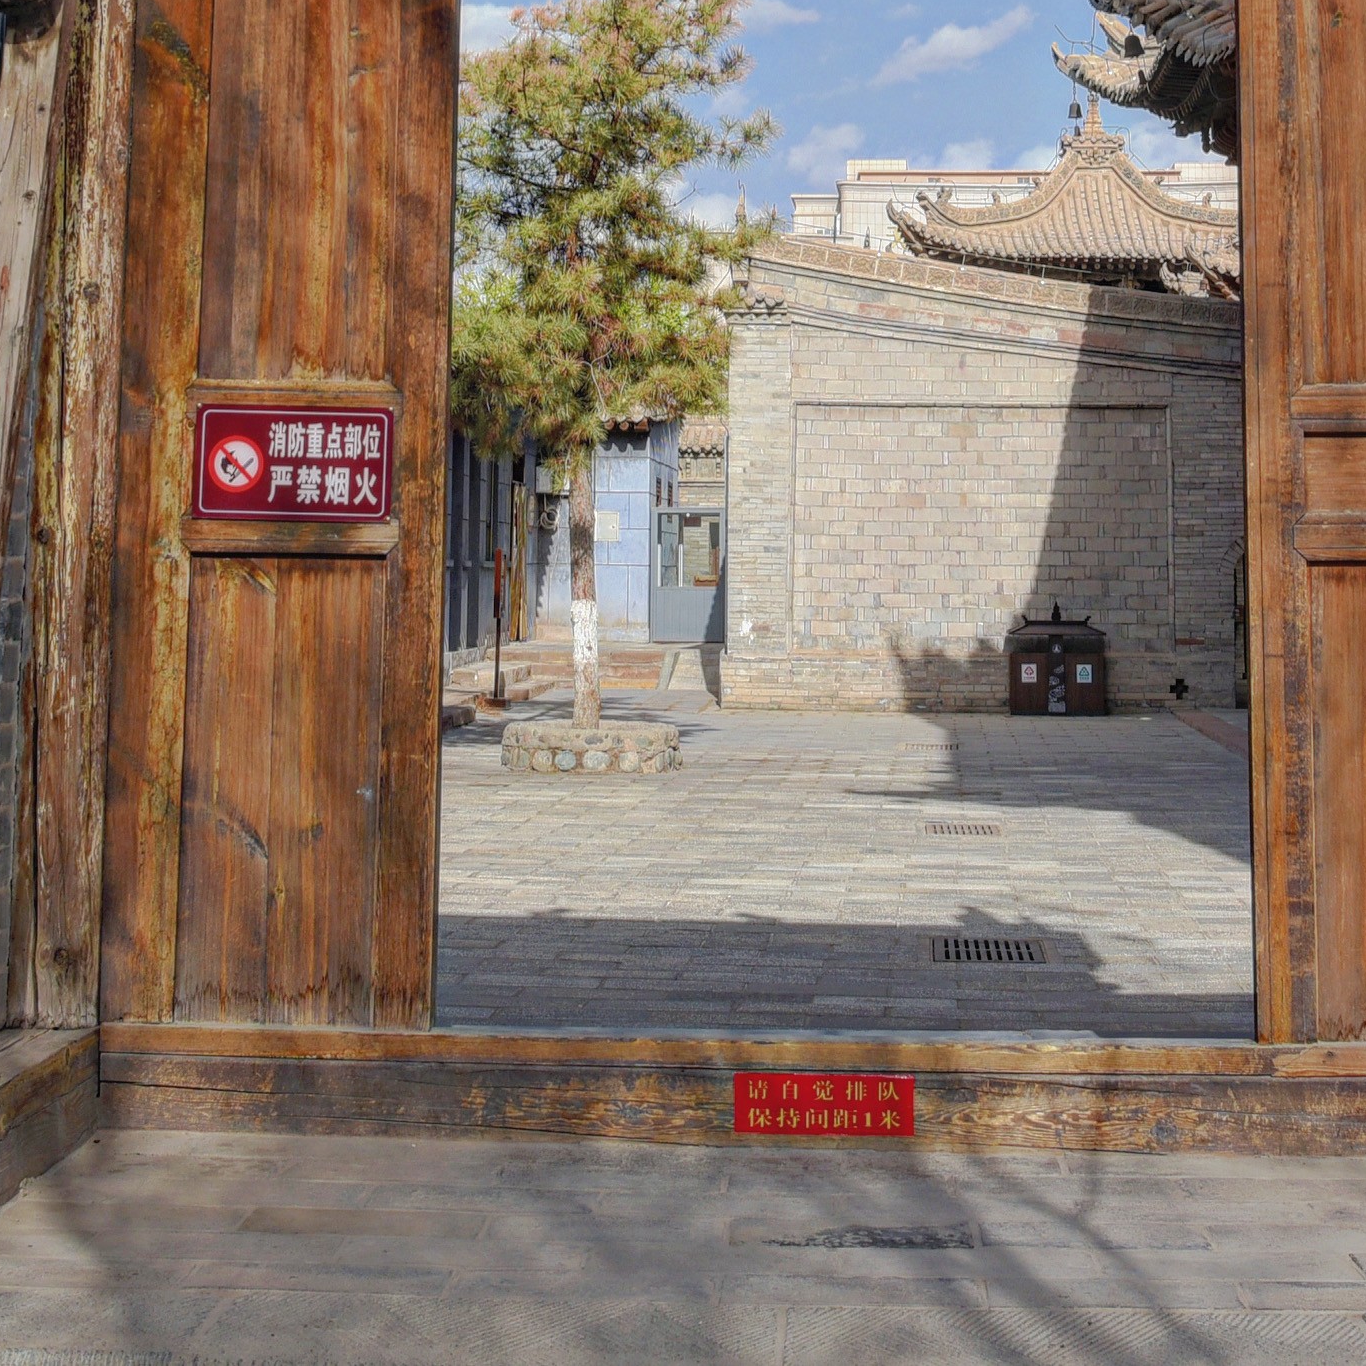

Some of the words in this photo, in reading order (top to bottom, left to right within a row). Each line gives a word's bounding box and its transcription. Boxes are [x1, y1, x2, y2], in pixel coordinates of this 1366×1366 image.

[268, 421, 381, 460] 消防重点部位
[267, 465, 378, 506] 严禁烟火
[748, 1079, 900, 1102] 请自觉排队
[747, 1107, 901, 1130] 保持间距1米
